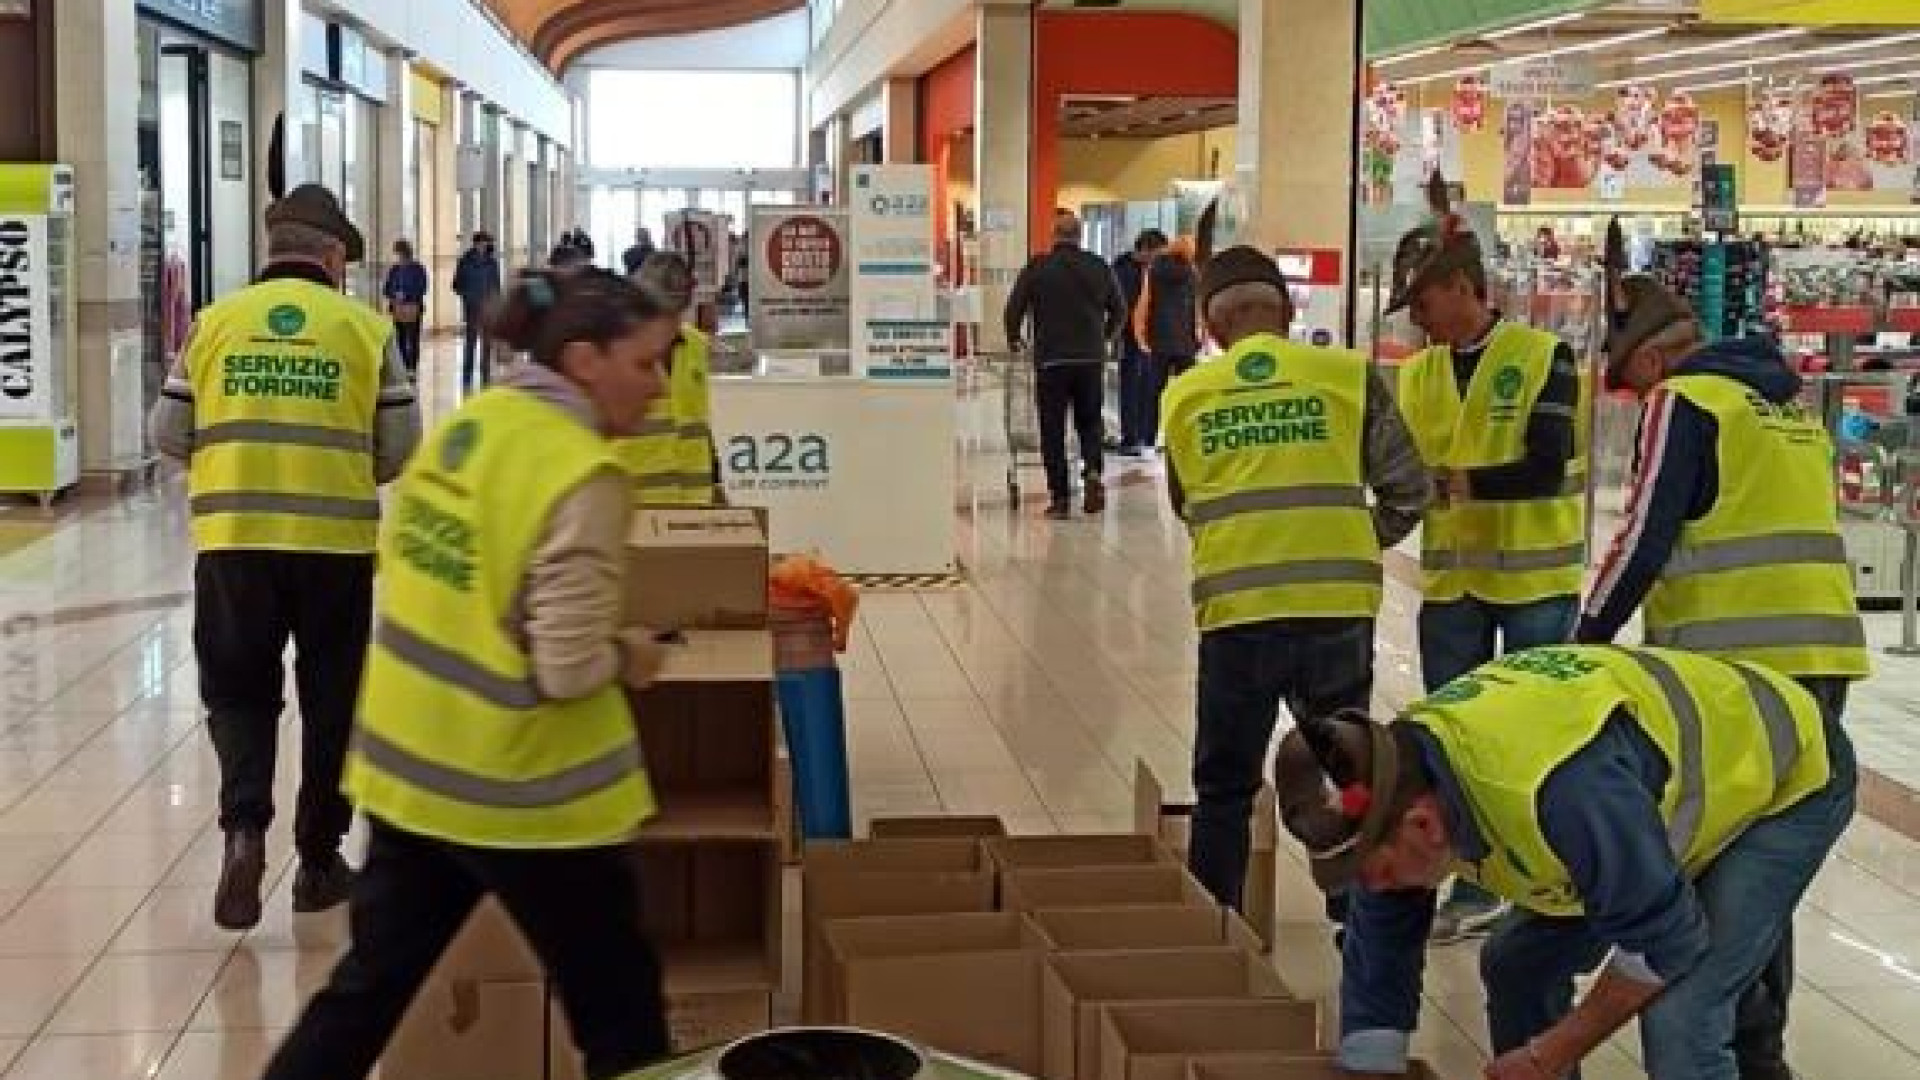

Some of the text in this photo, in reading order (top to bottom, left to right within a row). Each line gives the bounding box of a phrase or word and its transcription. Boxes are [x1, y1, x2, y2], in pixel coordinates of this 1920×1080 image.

[0, 220, 30, 399] CALYPSO
[224, 355, 340, 379] SERVIZIO
[224, 377, 340, 400] D'ORDINE
[1199, 396, 1324, 433] SERVIZIO
[728, 432, 829, 473] a2a
